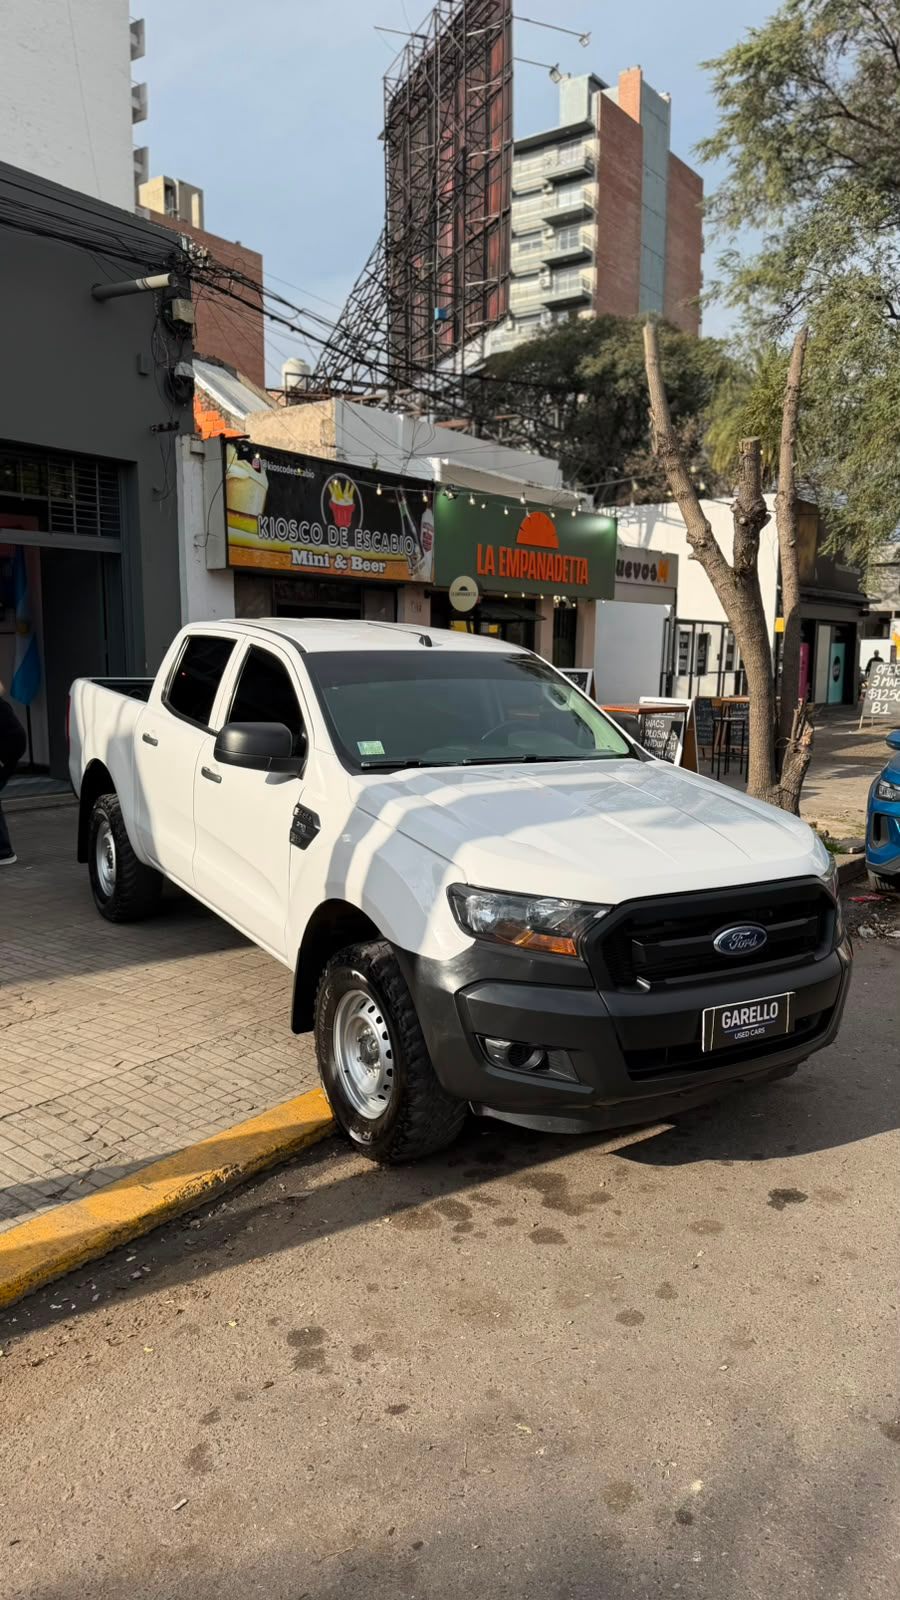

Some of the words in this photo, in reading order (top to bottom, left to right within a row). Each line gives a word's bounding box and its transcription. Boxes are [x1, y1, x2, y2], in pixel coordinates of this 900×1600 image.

[257, 515, 323, 545] KIOSCO
[327, 525, 349, 548] DE
[354, 528, 415, 556] ESCABIO
[291, 549, 330, 568] Mini
[334, 553, 348, 569] &
[351, 556, 386, 573] Beer
[477, 543, 495, 576] LA
[499, 547, 589, 584] EMPANADETTA
[871, 675, 880, 687] 3
[728, 931, 758, 950] Ford
[721, 1002, 779, 1029] GARELLO
[734, 1030, 750, 1040] USED
[750, 1026, 766, 1037] CARS
